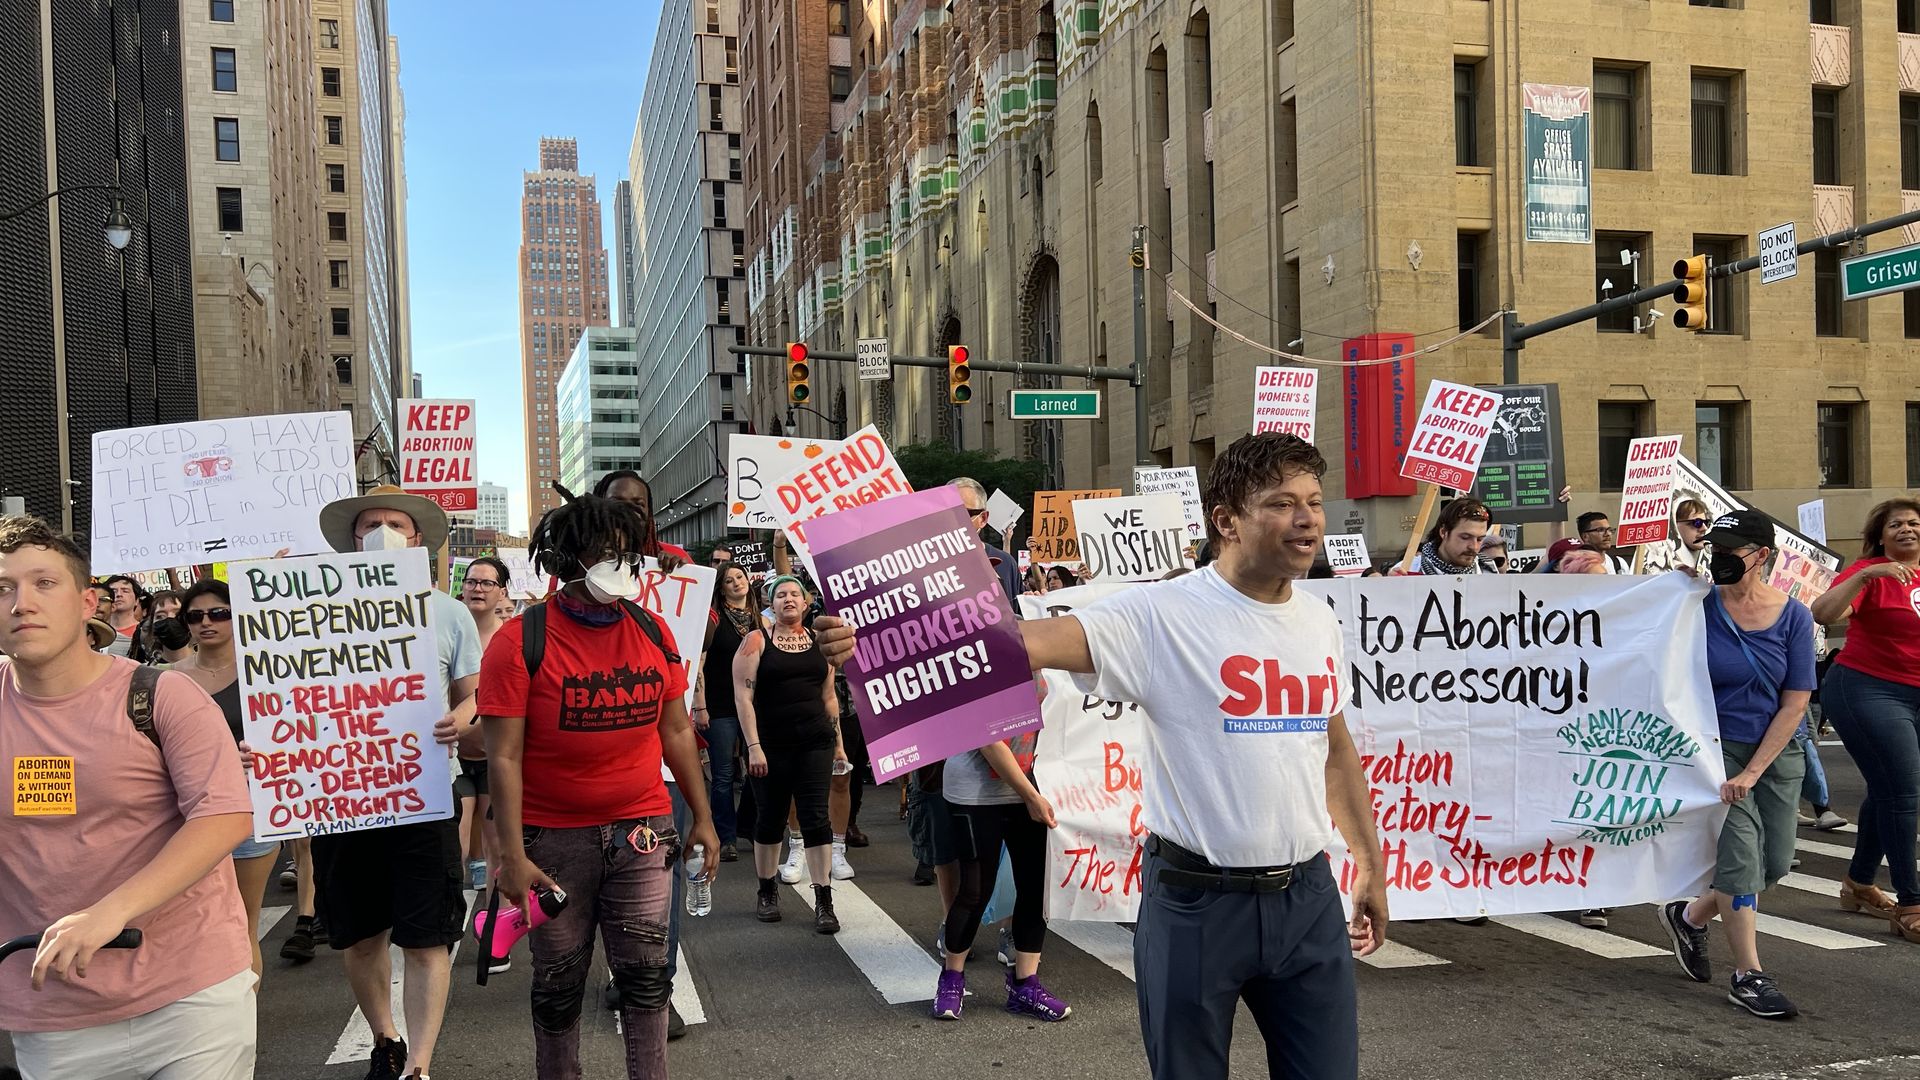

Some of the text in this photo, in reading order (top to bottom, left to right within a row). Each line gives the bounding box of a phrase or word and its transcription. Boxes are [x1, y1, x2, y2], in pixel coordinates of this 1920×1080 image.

[1544, 128, 1571, 142] OFFICE
[1543, 142, 1572, 158] SPACE
[1533, 159, 1583, 176] AVAILABLE
[1761, 229, 1794, 251] DO NOT
[1762, 247, 1795, 268] BLOCK
[1763, 263, 1796, 279] INTERSECTION
[1867, 260, 1920, 284] Grisw
[858, 343, 887, 354] DO NOT
[859, 356, 888, 367] BLOCK
[859, 368, 889, 376] INTERSECTION
[1259, 371, 1314, 388] DEFEND
[1350, 383, 1358, 396] of
[1034, 398, 1077, 411] Larned
[1258, 392, 1310, 403] WOMEN'S &
[1392, 343, 1405, 447] Bank of America
[1432, 387, 1495, 418] KEEP
[1505, 397, 1522, 405] OFF
[1524, 396, 1542, 404] OUR
[407, 405, 471, 431] KEEP
[1256, 407, 1310, 417] REPRODUCTIVE
[1256, 421, 1311, 439] RIGHTS
[1350, 398, 1359, 451] America
[1421, 414, 1488, 439] ABORTION
[97, 428, 197, 464] FORCED
[251, 416, 339, 446] HAVE
[402, 437, 474, 452] ABORTION
[1412, 431, 1480, 465] LEGAL
[1630, 440, 1678, 462] DEFEND
[97, 445, 350, 498] THE KIDS U
[403, 457, 473, 483] LEGAL
[777, 434, 886, 515] DEFEND
[1628, 464, 1672, 480] WOMEN'S &
[1625, 482, 1671, 496] REPRODUCTIVE
[92, 485, 255, 540] LET DIE in
[1103, 508, 1144, 529] WE
[1623, 497, 1669, 520] RIGHTS
[1038, 517, 1069, 538] AID
[1505, 529, 1516, 539] NOT
[120, 530, 296, 561] PRO BIRTH PRO LIFE
[1081, 527, 1184, 579] DISSENT
[1328, 538, 1360, 547] ABORT
[1337, 548, 1356, 557] THE
[1785, 536, 1828, 565] HYENAS
[826, 527, 976, 601] REPRODUCTIVE
[1332, 557, 1364, 567] COURT
[246, 563, 342, 602] BUILD
[349, 563, 398, 589] THE
[838, 566, 966, 630] RIGHTS ARE
[238, 591, 432, 647] INDEPENDENT
[854, 582, 1002, 674] WORKERS'
[1358, 589, 1603, 656] to Abortion
[777, 643, 797, 651] DEAD
[244, 635, 416, 686] MOVEMENT
[864, 639, 993, 716] RIGHTS!
[1218, 654, 1339, 717] Shri
[1350, 657, 1589, 714] Necessary!
[247, 674, 427, 721] NO RELIANCE
[565, 682, 662, 708] BAMN
[582, 711, 598, 720] ANY
[603, 710, 627, 719] MEANS
[1228, 720, 1284, 731] THANEDAR
[1286, 721, 1298, 731] for
[271, 710, 390, 744] ON THE
[1557, 708, 1701, 758] BY ANY MEANS
[893, 745, 919, 759] MICHIGAN
[1581, 730, 1679, 760] NECESSARY
[18, 759, 71, 770] ABORTION
[251, 733, 422, 781] DEMOCRATS
[895, 752, 921, 769] AFL-CIO
[17, 771, 71, 780] ON DEMAND
[18, 782, 71, 791] & WITHOUT
[262, 762, 423, 802] TO DEFEND
[1572, 758, 1669, 795] JOIN
[17, 792, 73, 803] APOLOGY!
[270, 787, 426, 828] OUR RIGHTS
[1568, 790, 1683, 825] BAMN
[306, 814, 397, 837] BAMN.COM
[1060, 844, 1116, 896] The
[1383, 837, 1434, 891] the
[1440, 837, 1595, 890] Streets!
